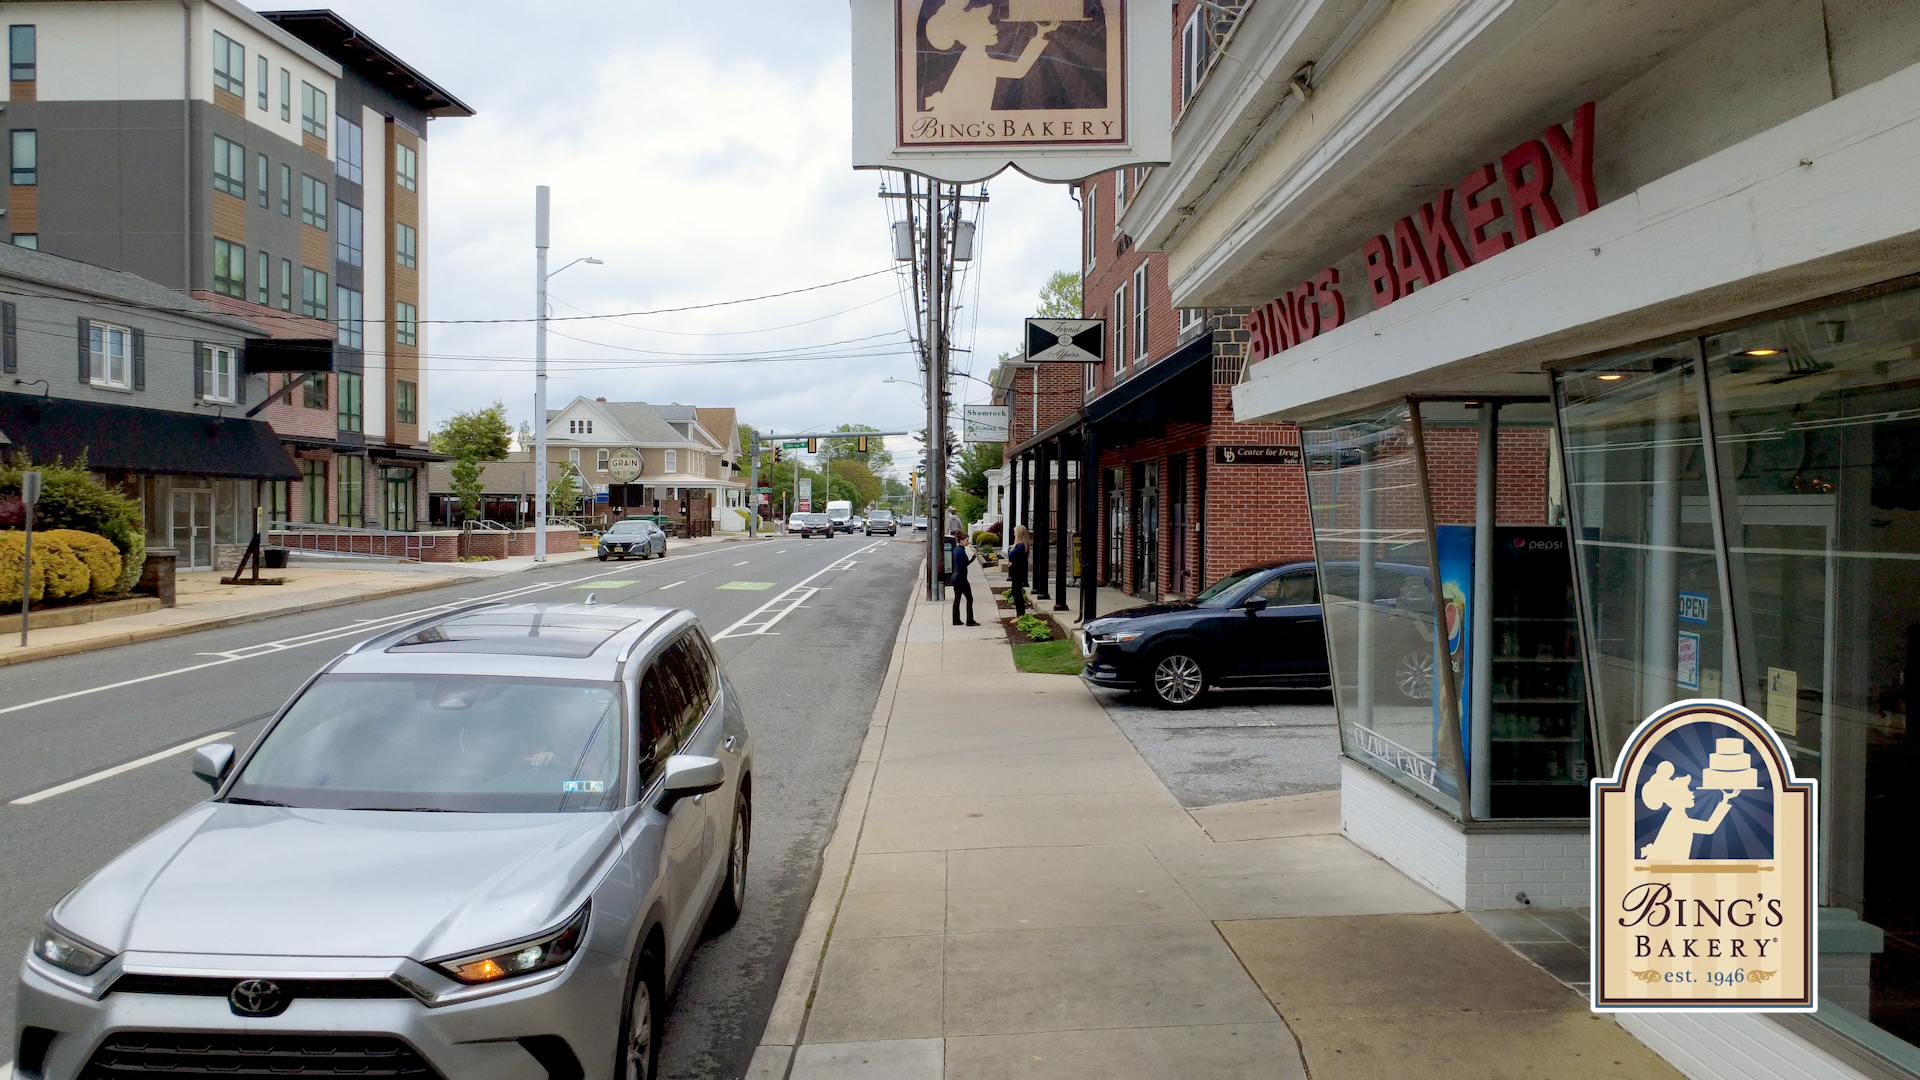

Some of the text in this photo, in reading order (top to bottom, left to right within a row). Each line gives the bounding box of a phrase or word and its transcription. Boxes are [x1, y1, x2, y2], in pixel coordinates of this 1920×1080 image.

[911, 116, 1114, 139] BING'S BAKERY
[1248, 101, 1600, 363] BINGS BAKERY
[1050, 321, 1083, 334] Formal
[1047, 349, 1080, 360] Affairs
[1237, 448, 1264, 456] Center
[1266, 448, 1278, 456] for
[1279, 448, 1299, 458] Drug
[612, 459, 638, 467] GRAIN
[1529, 540, 1563, 550] pepsi
[1679, 596, 1705, 619] OPEN
